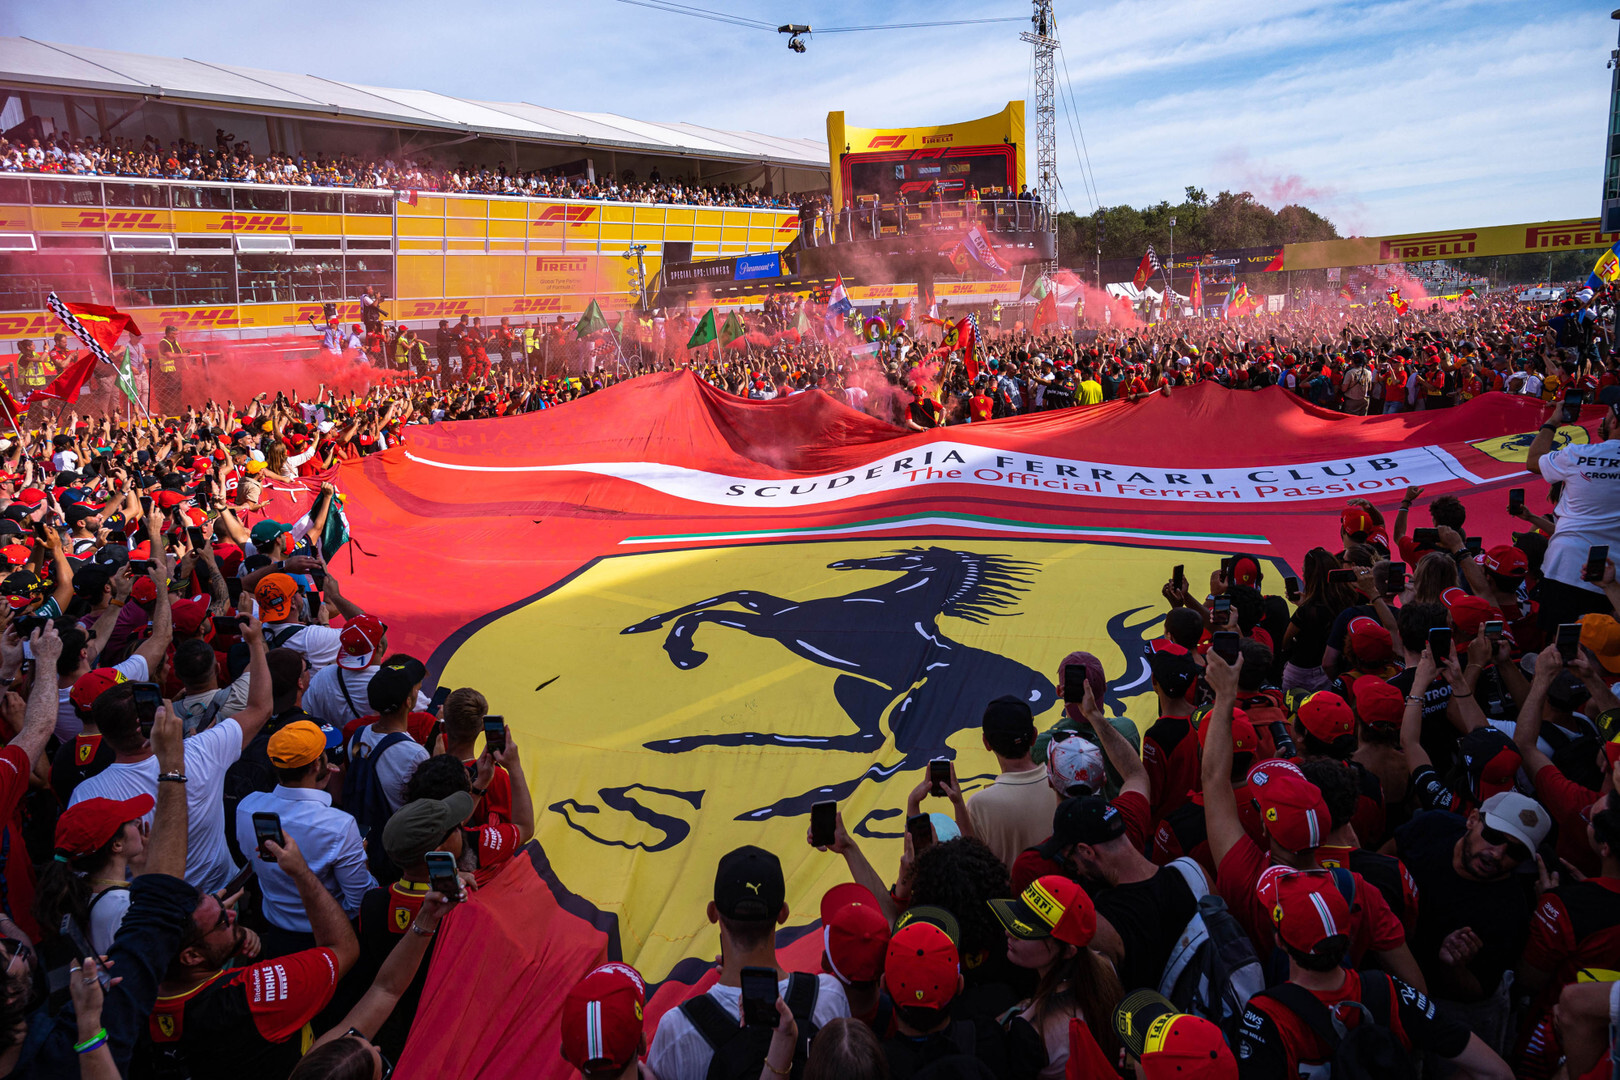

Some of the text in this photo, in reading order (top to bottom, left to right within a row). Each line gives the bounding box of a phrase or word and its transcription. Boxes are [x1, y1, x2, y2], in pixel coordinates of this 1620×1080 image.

[867, 135, 908, 148] F1
[922, 133, 953, 144] PIRELLI
[909, 147, 948, 160] F1
[78, 211, 162, 229] DHL
[220, 215, 291, 231] DHL
[533, 206, 596, 227] F1
[1380, 232, 1478, 259] PIRELLI
[536, 257, 588, 272] PIRELLI
[739, 261, 775, 275] Paramount+
[670, 270, 692, 281] SPECIAL
[413, 301, 471, 316] DHL
[512, 297, 564, 313] DHL
[159, 309, 240, 327] DHL
[725, 449, 1400, 497] SCUDERIA FERRARI CLUB
[902, 467, 1412, 499] The Official Ferrari Passion
[252, 968, 261, 1002] Bitdefender
[262, 965, 276, 1002] MAHLE
[1244, 1009, 1264, 1026] aws
